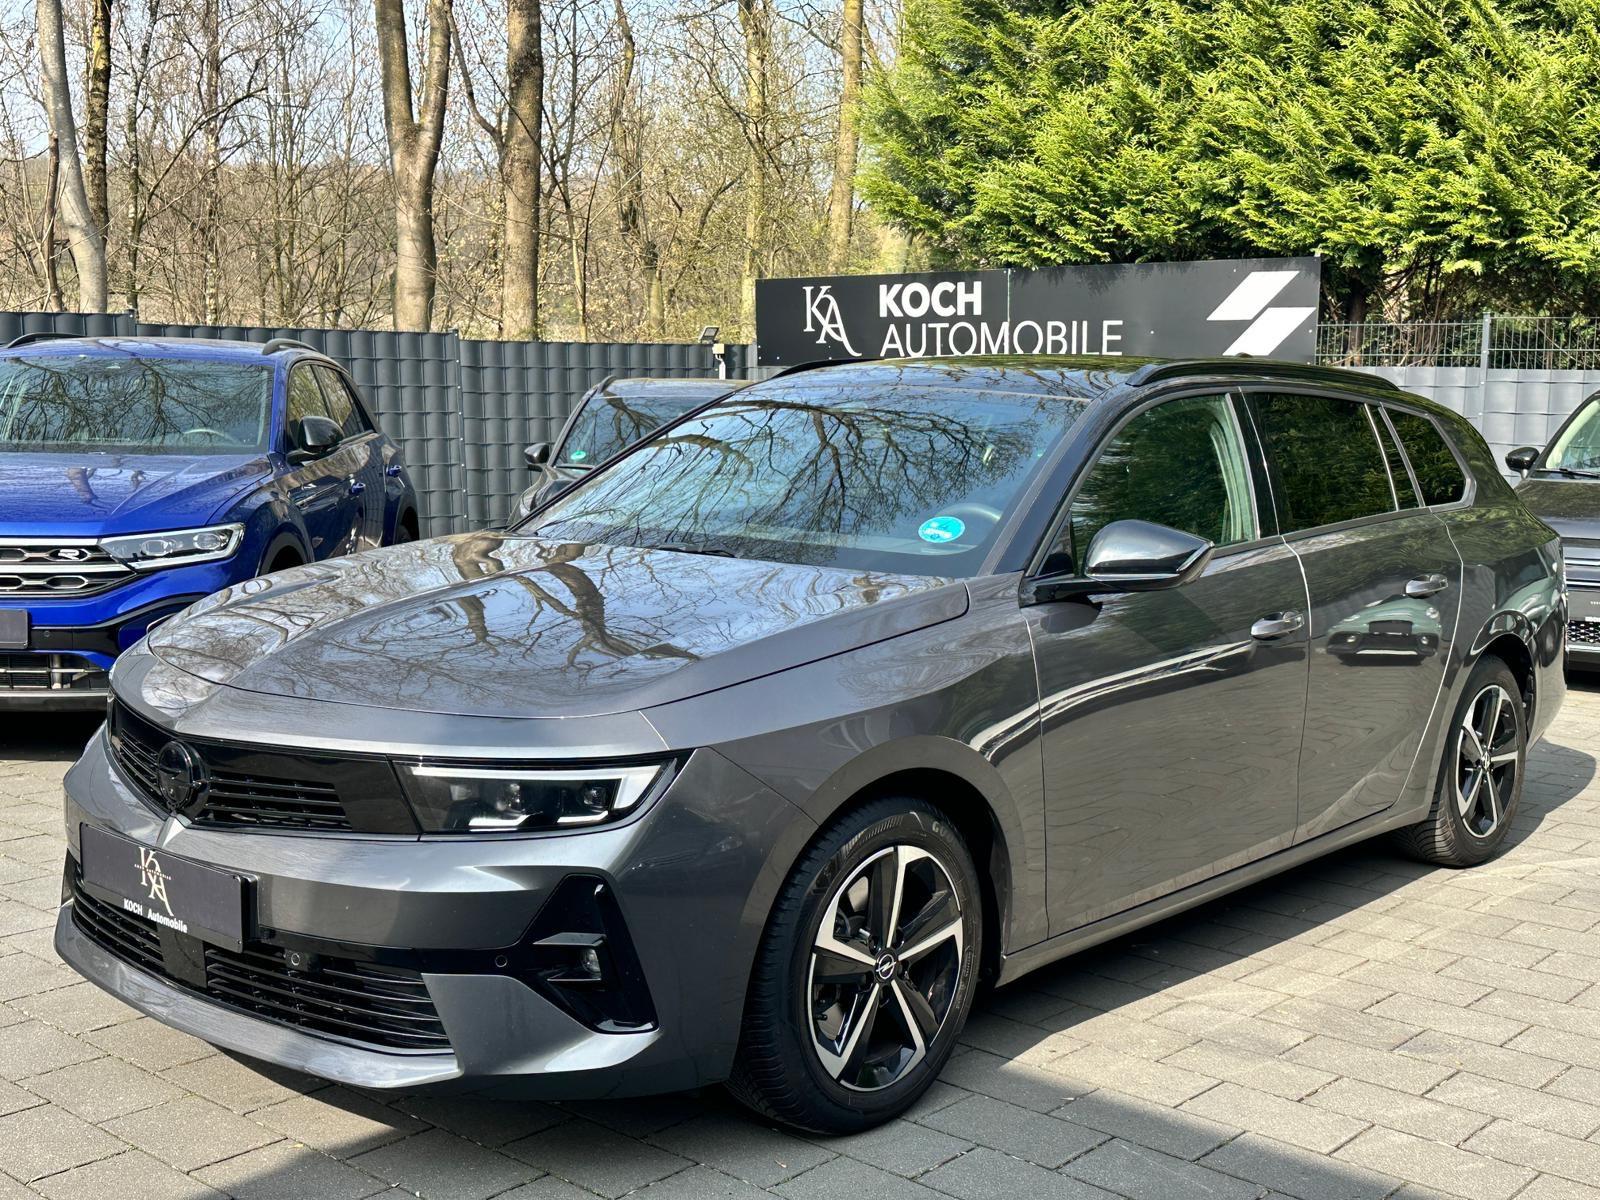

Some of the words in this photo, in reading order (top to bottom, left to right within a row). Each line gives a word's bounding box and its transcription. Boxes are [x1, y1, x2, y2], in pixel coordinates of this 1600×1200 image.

[879, 280, 982, 318] KOCH
[879, 320, 1124, 357] AUTOMOBILE
[123, 897, 143, 916] KOCH
[147, 907, 188, 934] Automobile
